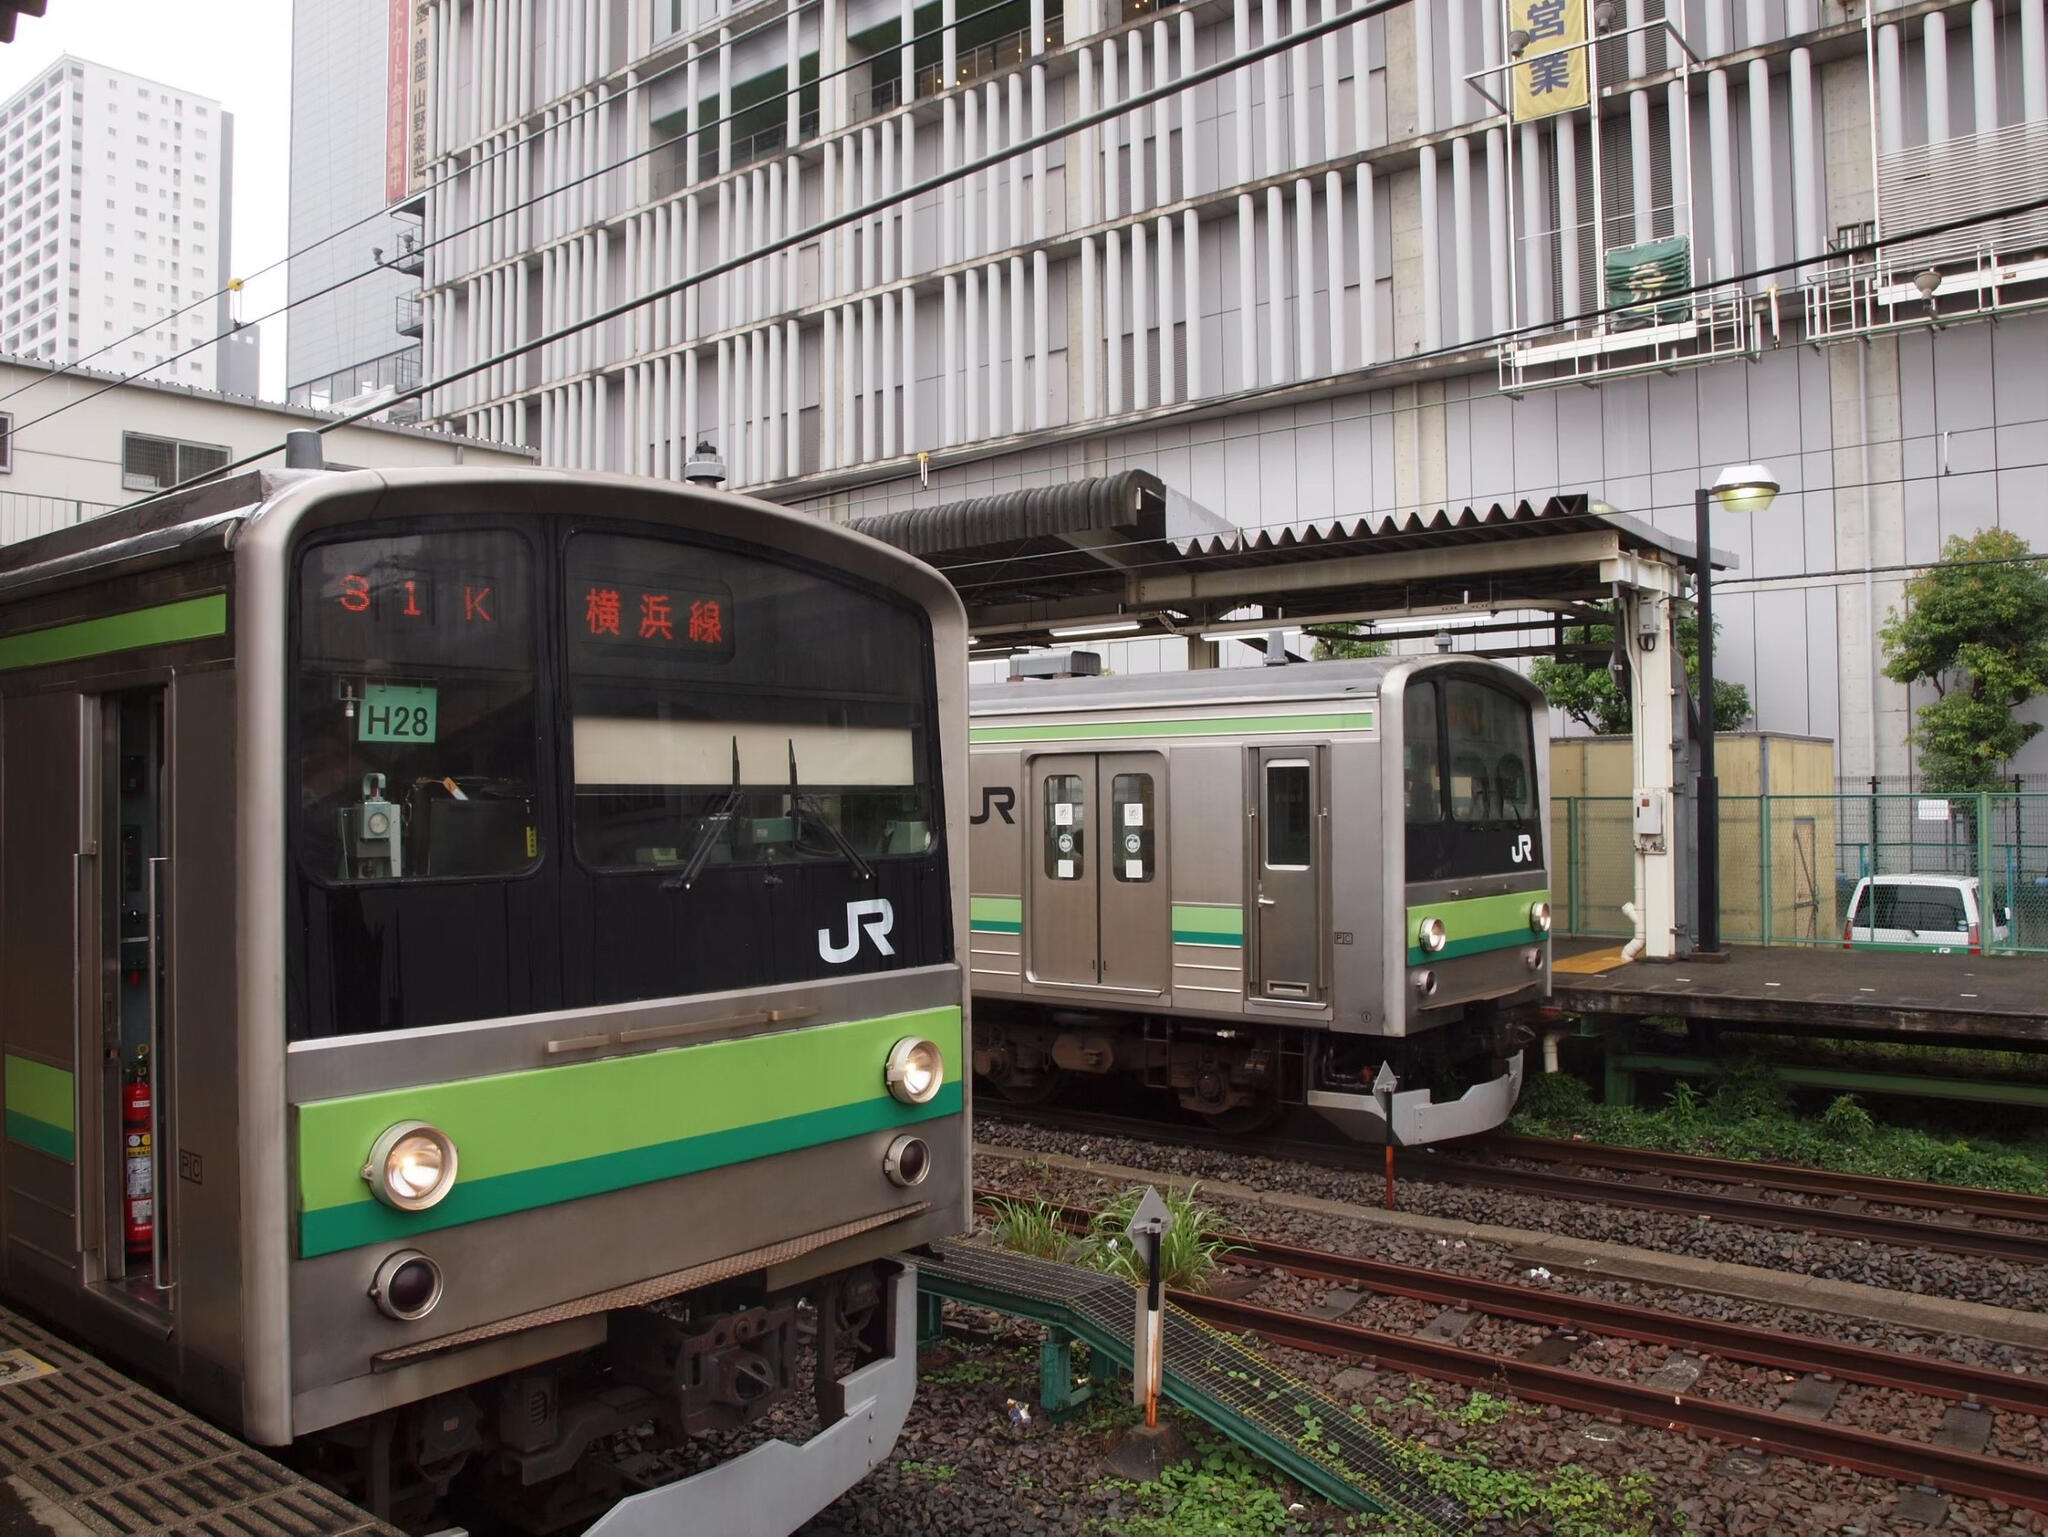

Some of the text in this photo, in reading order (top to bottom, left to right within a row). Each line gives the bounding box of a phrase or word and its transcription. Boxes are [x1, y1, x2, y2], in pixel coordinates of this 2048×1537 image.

[1527, 0, 1570, 97] 営業
[586, 588, 722, 644] 横浜線
[367, 705, 429, 737] H28
[970, 786, 1017, 826] JR
[1511, 834, 1533, 874] JR
[818, 898, 896, 964] JR
